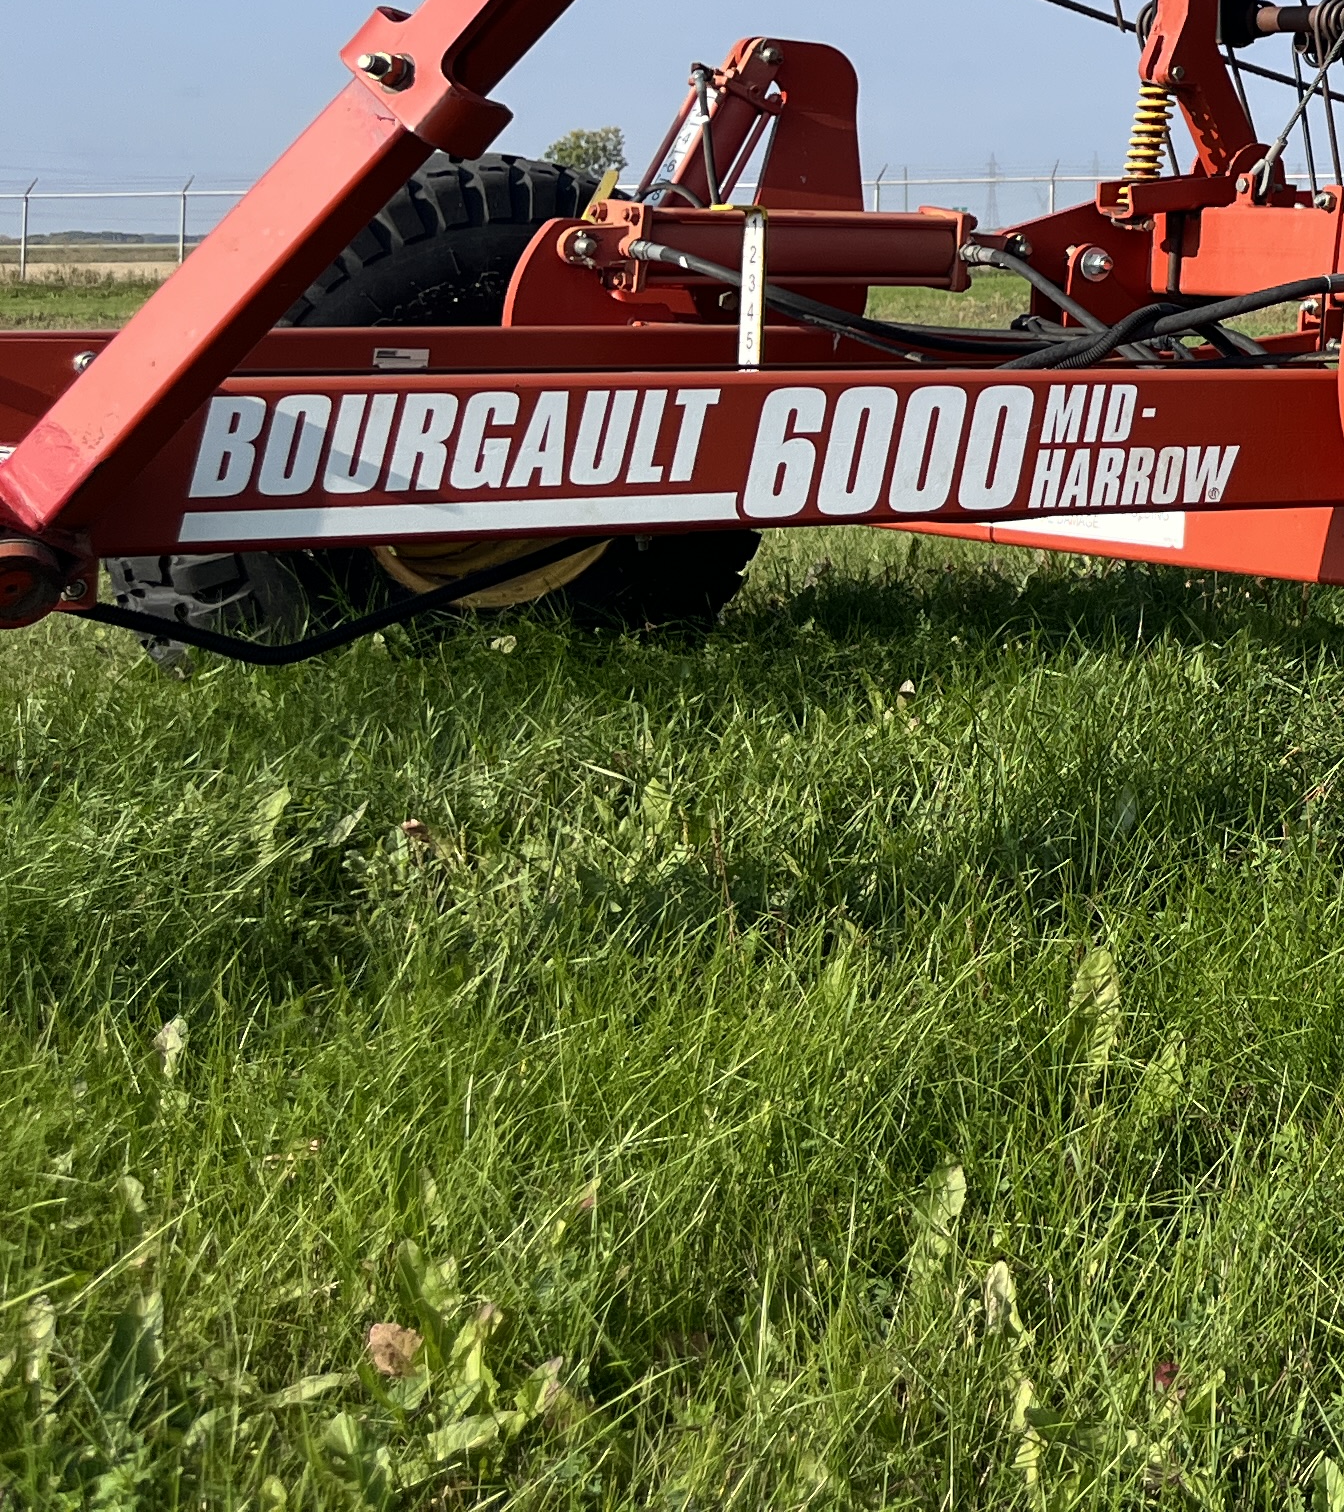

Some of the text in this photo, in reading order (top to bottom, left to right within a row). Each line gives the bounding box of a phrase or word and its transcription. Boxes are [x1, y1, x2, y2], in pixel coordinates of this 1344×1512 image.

[667, 159, 677, 173] 6
[749, 245, 757, 264] 2
[748, 274, 756, 292] 3
[746, 302, 754, 320] 4
[746, 331, 754, 350] 5
[1040, 384, 1156, 443] MID-
[189, 385, 1034, 518] BOURGAULT 6000
[1028, 445, 1241, 508] HARROW
